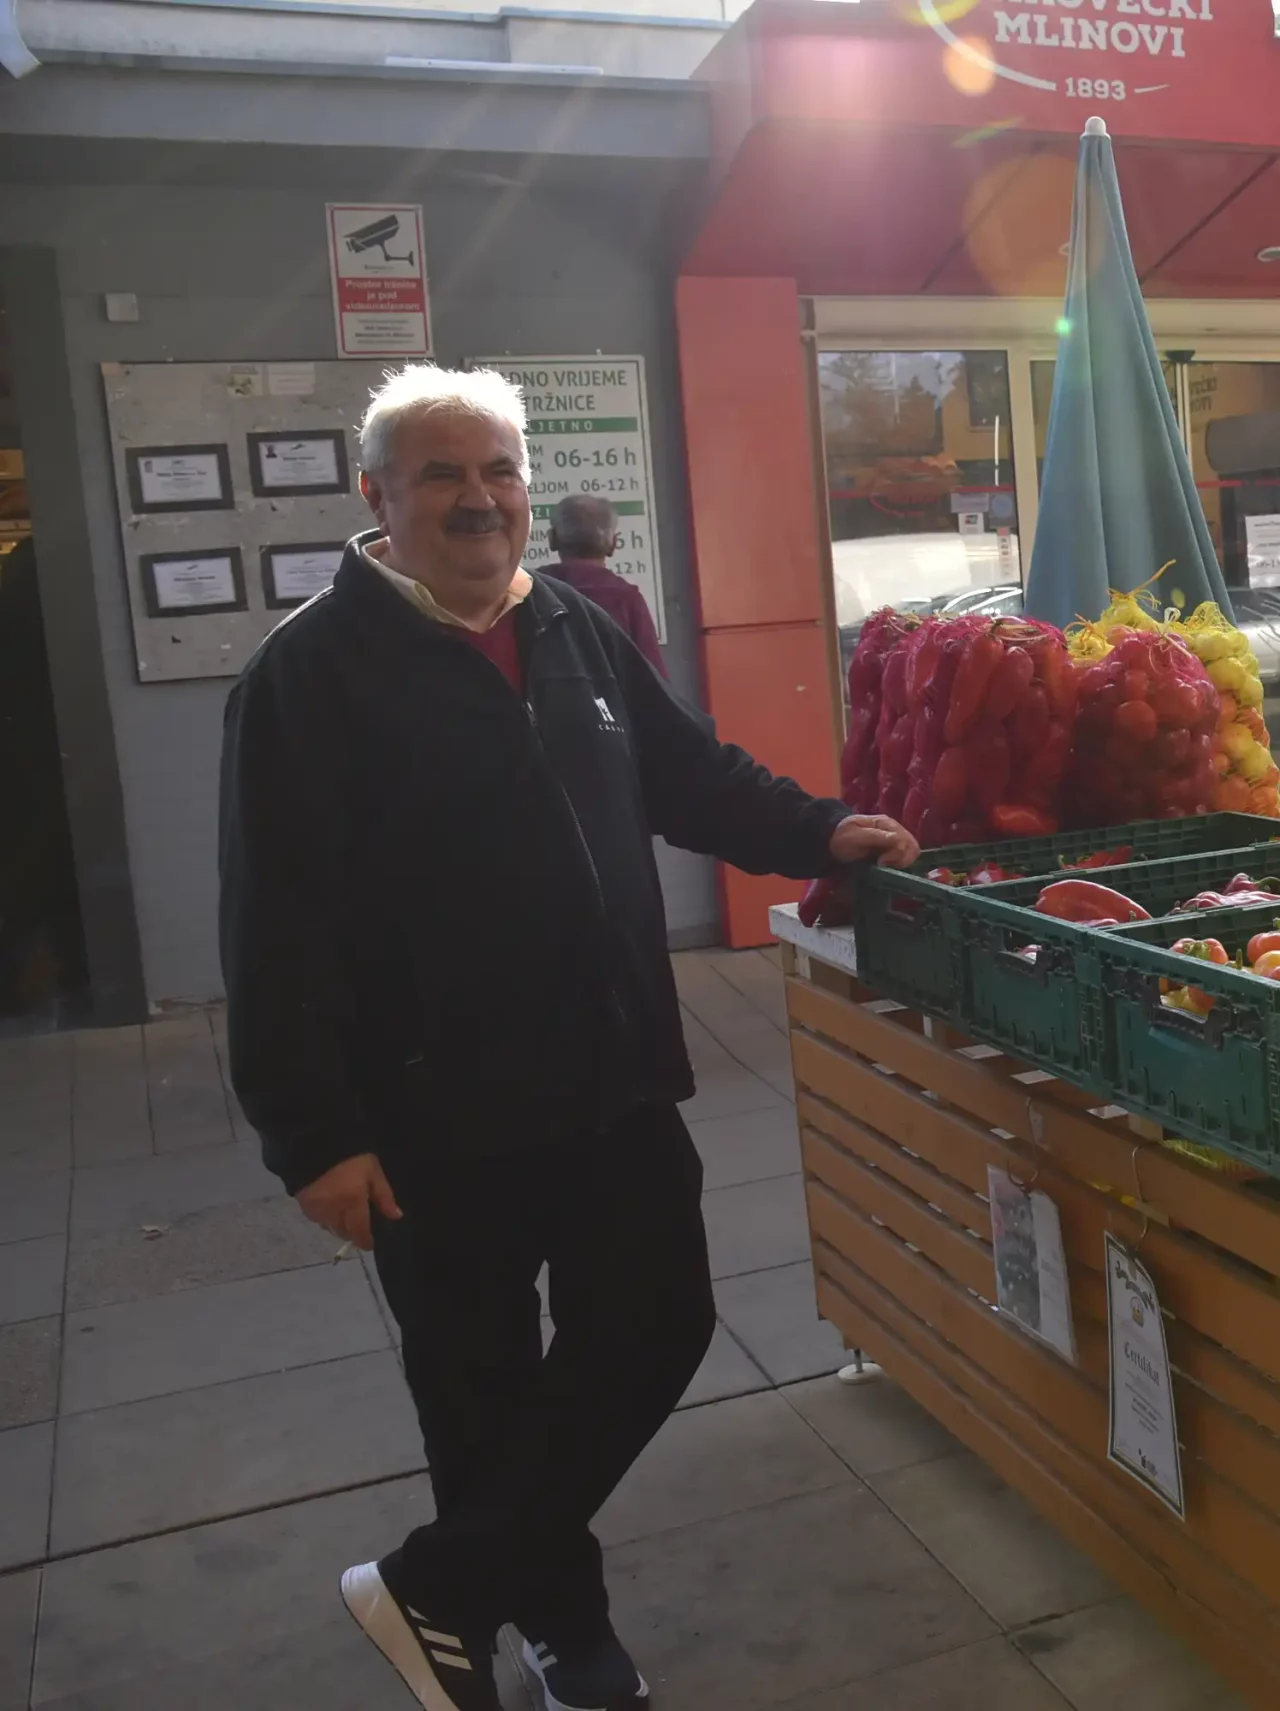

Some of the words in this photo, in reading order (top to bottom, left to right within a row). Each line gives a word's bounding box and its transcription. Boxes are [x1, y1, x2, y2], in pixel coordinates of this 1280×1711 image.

[993, 10, 1186, 57] MLINOVI
[1065, 77, 1127, 101] 1893
[553, 369, 627, 387] VRIJEME
[522, 392, 596, 412] TRŽNICE
[554, 448, 618, 468] 06-16
[624, 446, 637, 466] h
[580, 477, 625, 493] 06-12
[630, 476, 640, 491] h
[636, 559, 647, 574] h
